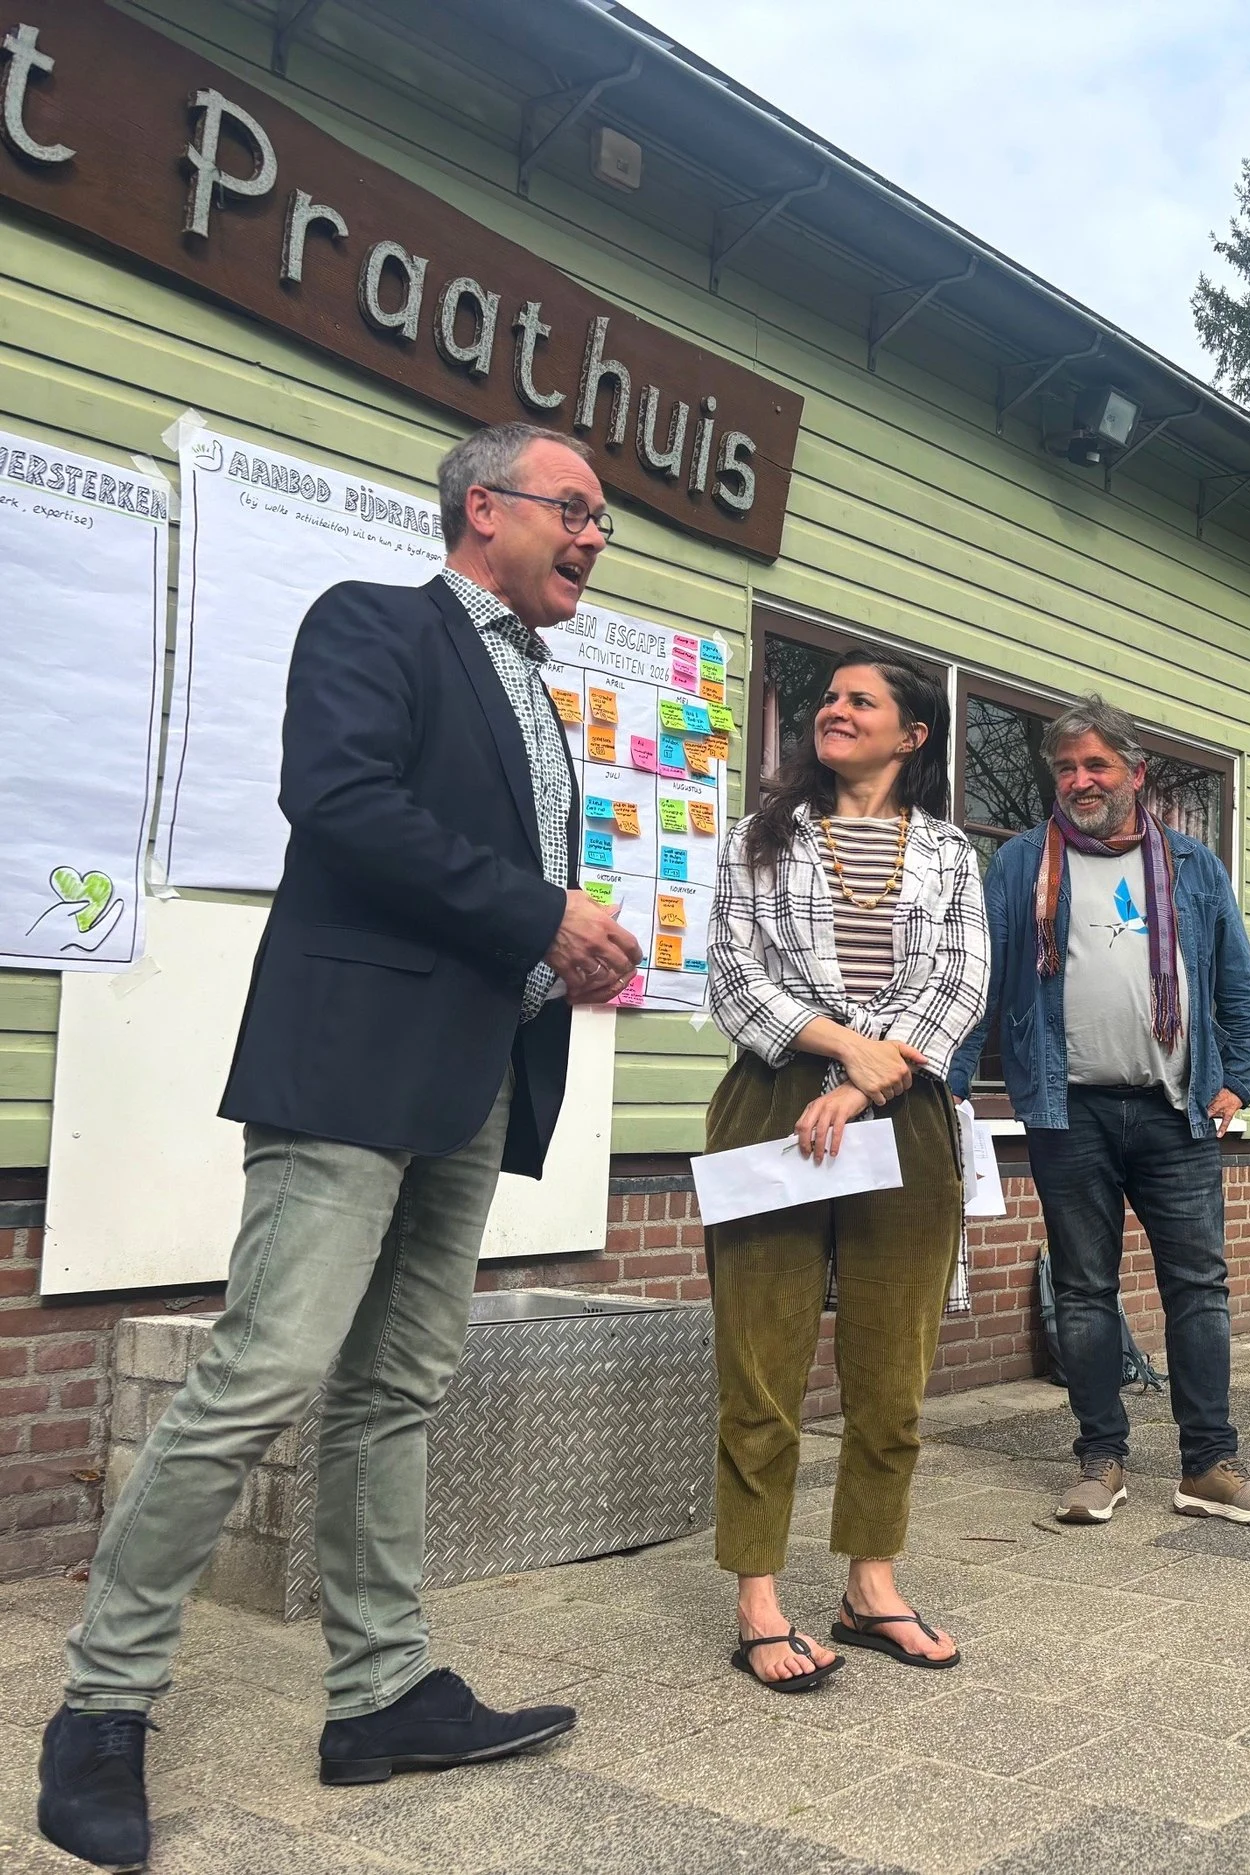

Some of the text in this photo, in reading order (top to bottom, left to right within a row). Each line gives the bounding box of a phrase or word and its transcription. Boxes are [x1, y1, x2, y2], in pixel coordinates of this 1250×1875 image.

[183, 87, 757, 512] Praathuis
[228, 451, 332, 503] AANBOD
[33, 504, 94, 530] expertise)
[264, 503, 288, 515] welke
[353, 528, 365, 539] wil
[367, 534, 376, 542] en
[379, 536, 392, 547] kun
[605, 622, 666, 659] ESCAPE
[578, 642, 645, 676] ACTIVITEITEN
[650, 664, 670, 682] 2026
[605, 677, 626, 690] APRIL
[676, 696, 689, 706] MEI
[604, 771, 621, 780] JULI
[672, 781, 703, 795] AUGUSTUS
[597, 873, 622, 883] OKTOBER
[669, 885, 696, 895] NOVEMBER
